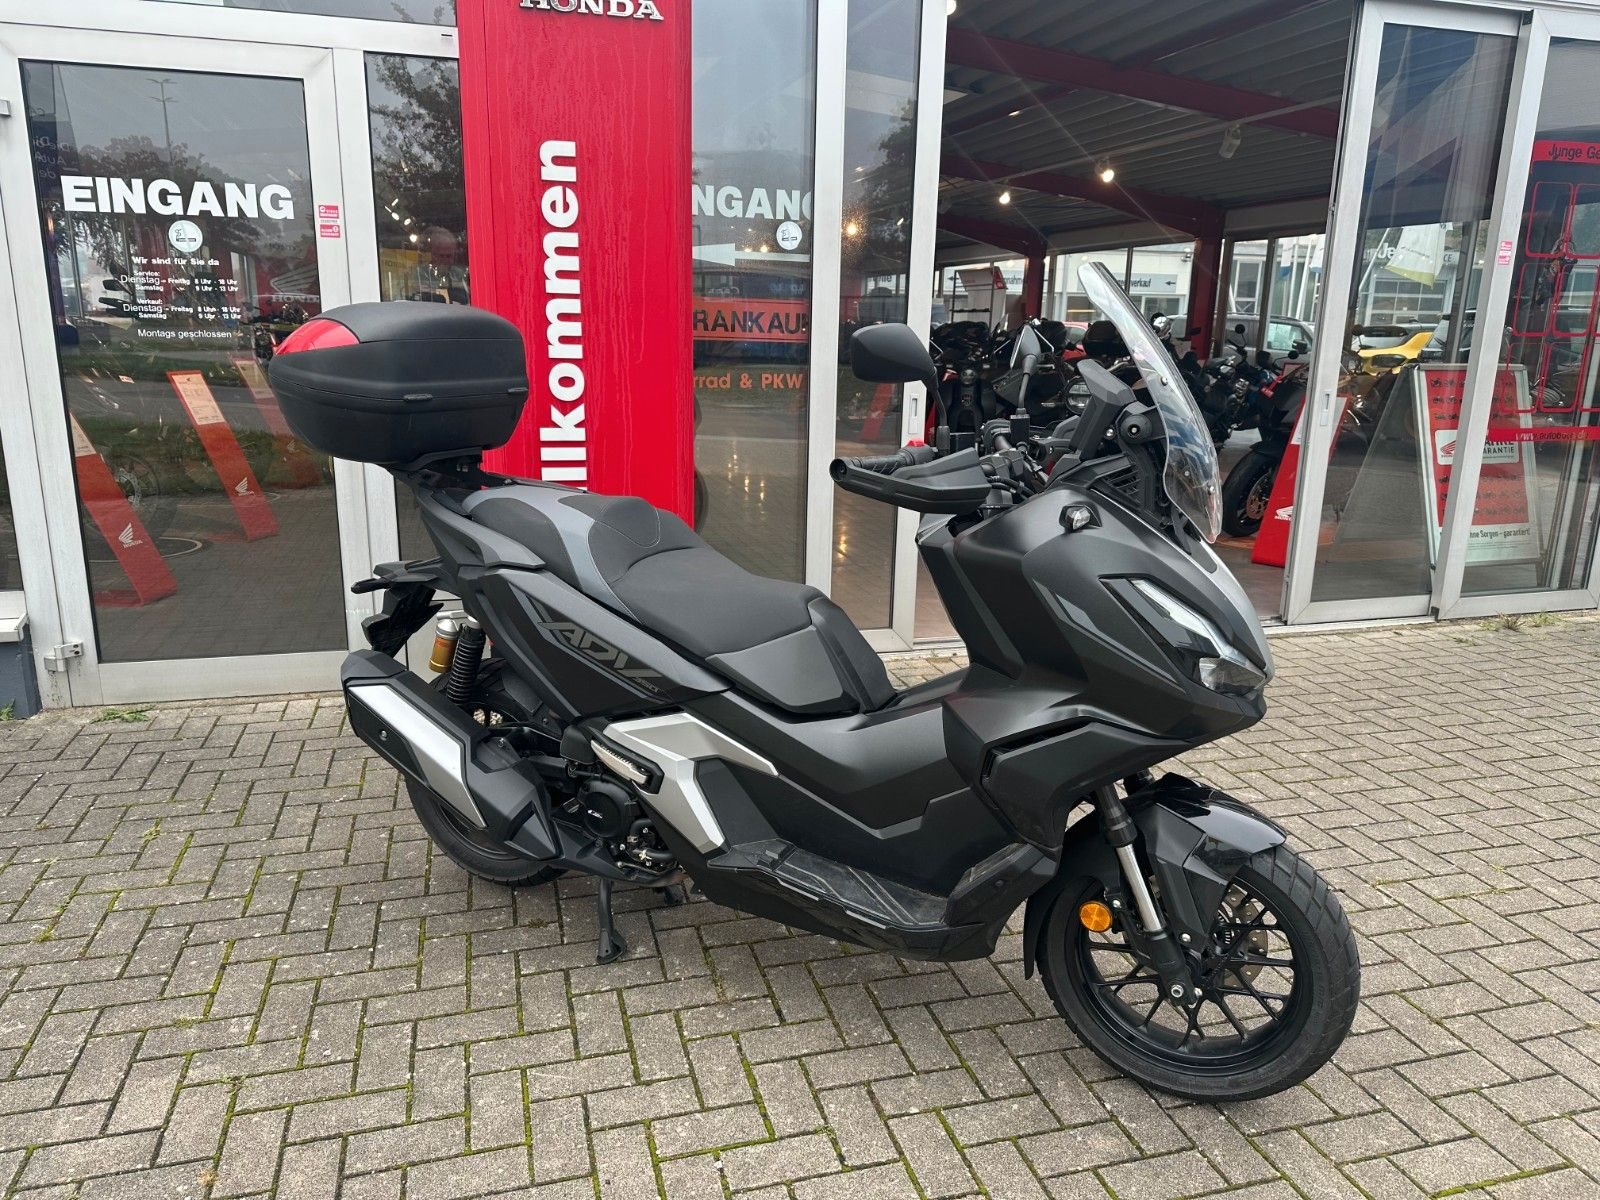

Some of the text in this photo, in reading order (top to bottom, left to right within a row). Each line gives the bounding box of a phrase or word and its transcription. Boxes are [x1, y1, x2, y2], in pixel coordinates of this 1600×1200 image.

[61, 175, 295, 220] EINGANG
[132, 256, 220, 266] Wir sind für Sie da
[120, 275, 160, 285] Dienstag
[168, 278, 191, 286] Freitag
[123, 304, 163, 313] Dienstag
[539, 139, 588, 492] llkommen
[137, 329, 232, 339] Montags geschlossen
[740, 373, 753, 389] &
[761, 373, 803, 389] PKW
[538, 622, 664, 678] ADV
